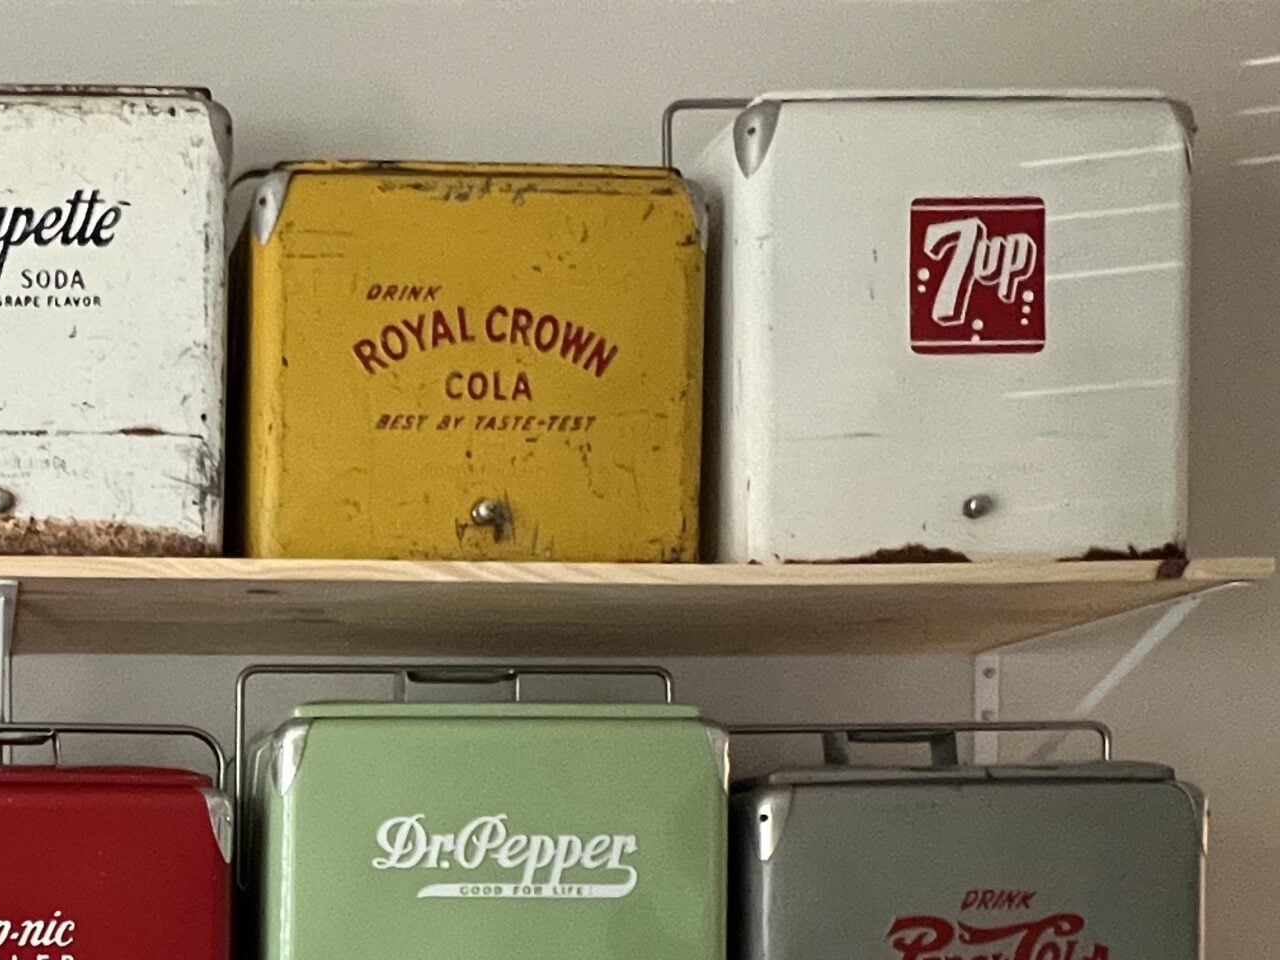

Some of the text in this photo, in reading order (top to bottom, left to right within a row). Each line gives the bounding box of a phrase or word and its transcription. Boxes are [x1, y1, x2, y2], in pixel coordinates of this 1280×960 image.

[20, 269, 86, 290] SODA
[47, 296, 102, 308] FLAVOR
[366, 284, 443, 301] DRINK
[352, 305, 619, 378] ROYAL CROWN
[444, 370, 533, 401] COLA
[375, 414, 597, 432] BEST BY TASTE-TEST
[459, 885, 503, 896] GOOD
[512, 885, 543, 896] FOR
[960, 889, 1037, 911] DRINK
